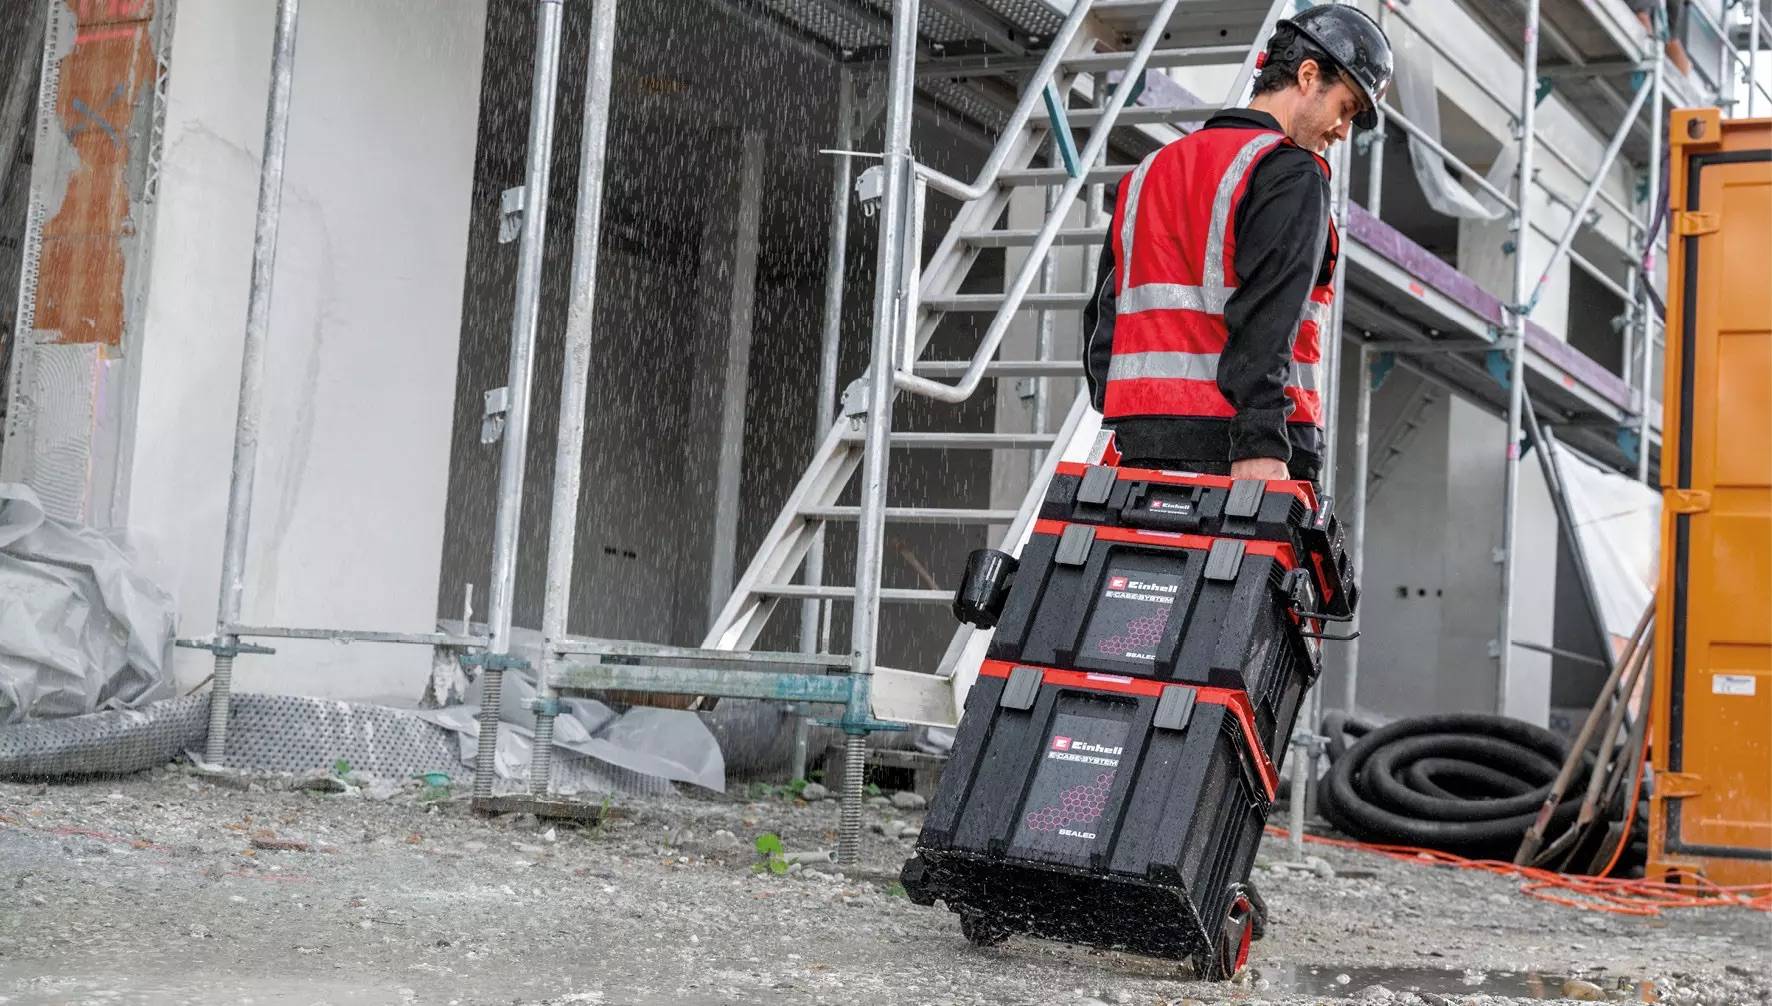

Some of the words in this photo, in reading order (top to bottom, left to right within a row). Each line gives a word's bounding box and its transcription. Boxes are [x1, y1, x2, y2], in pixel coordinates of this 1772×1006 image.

[1128, 580, 1179, 593] Einhell
[1071, 740, 1123, 755] Einhell
[1058, 828, 1097, 840] SEALED
